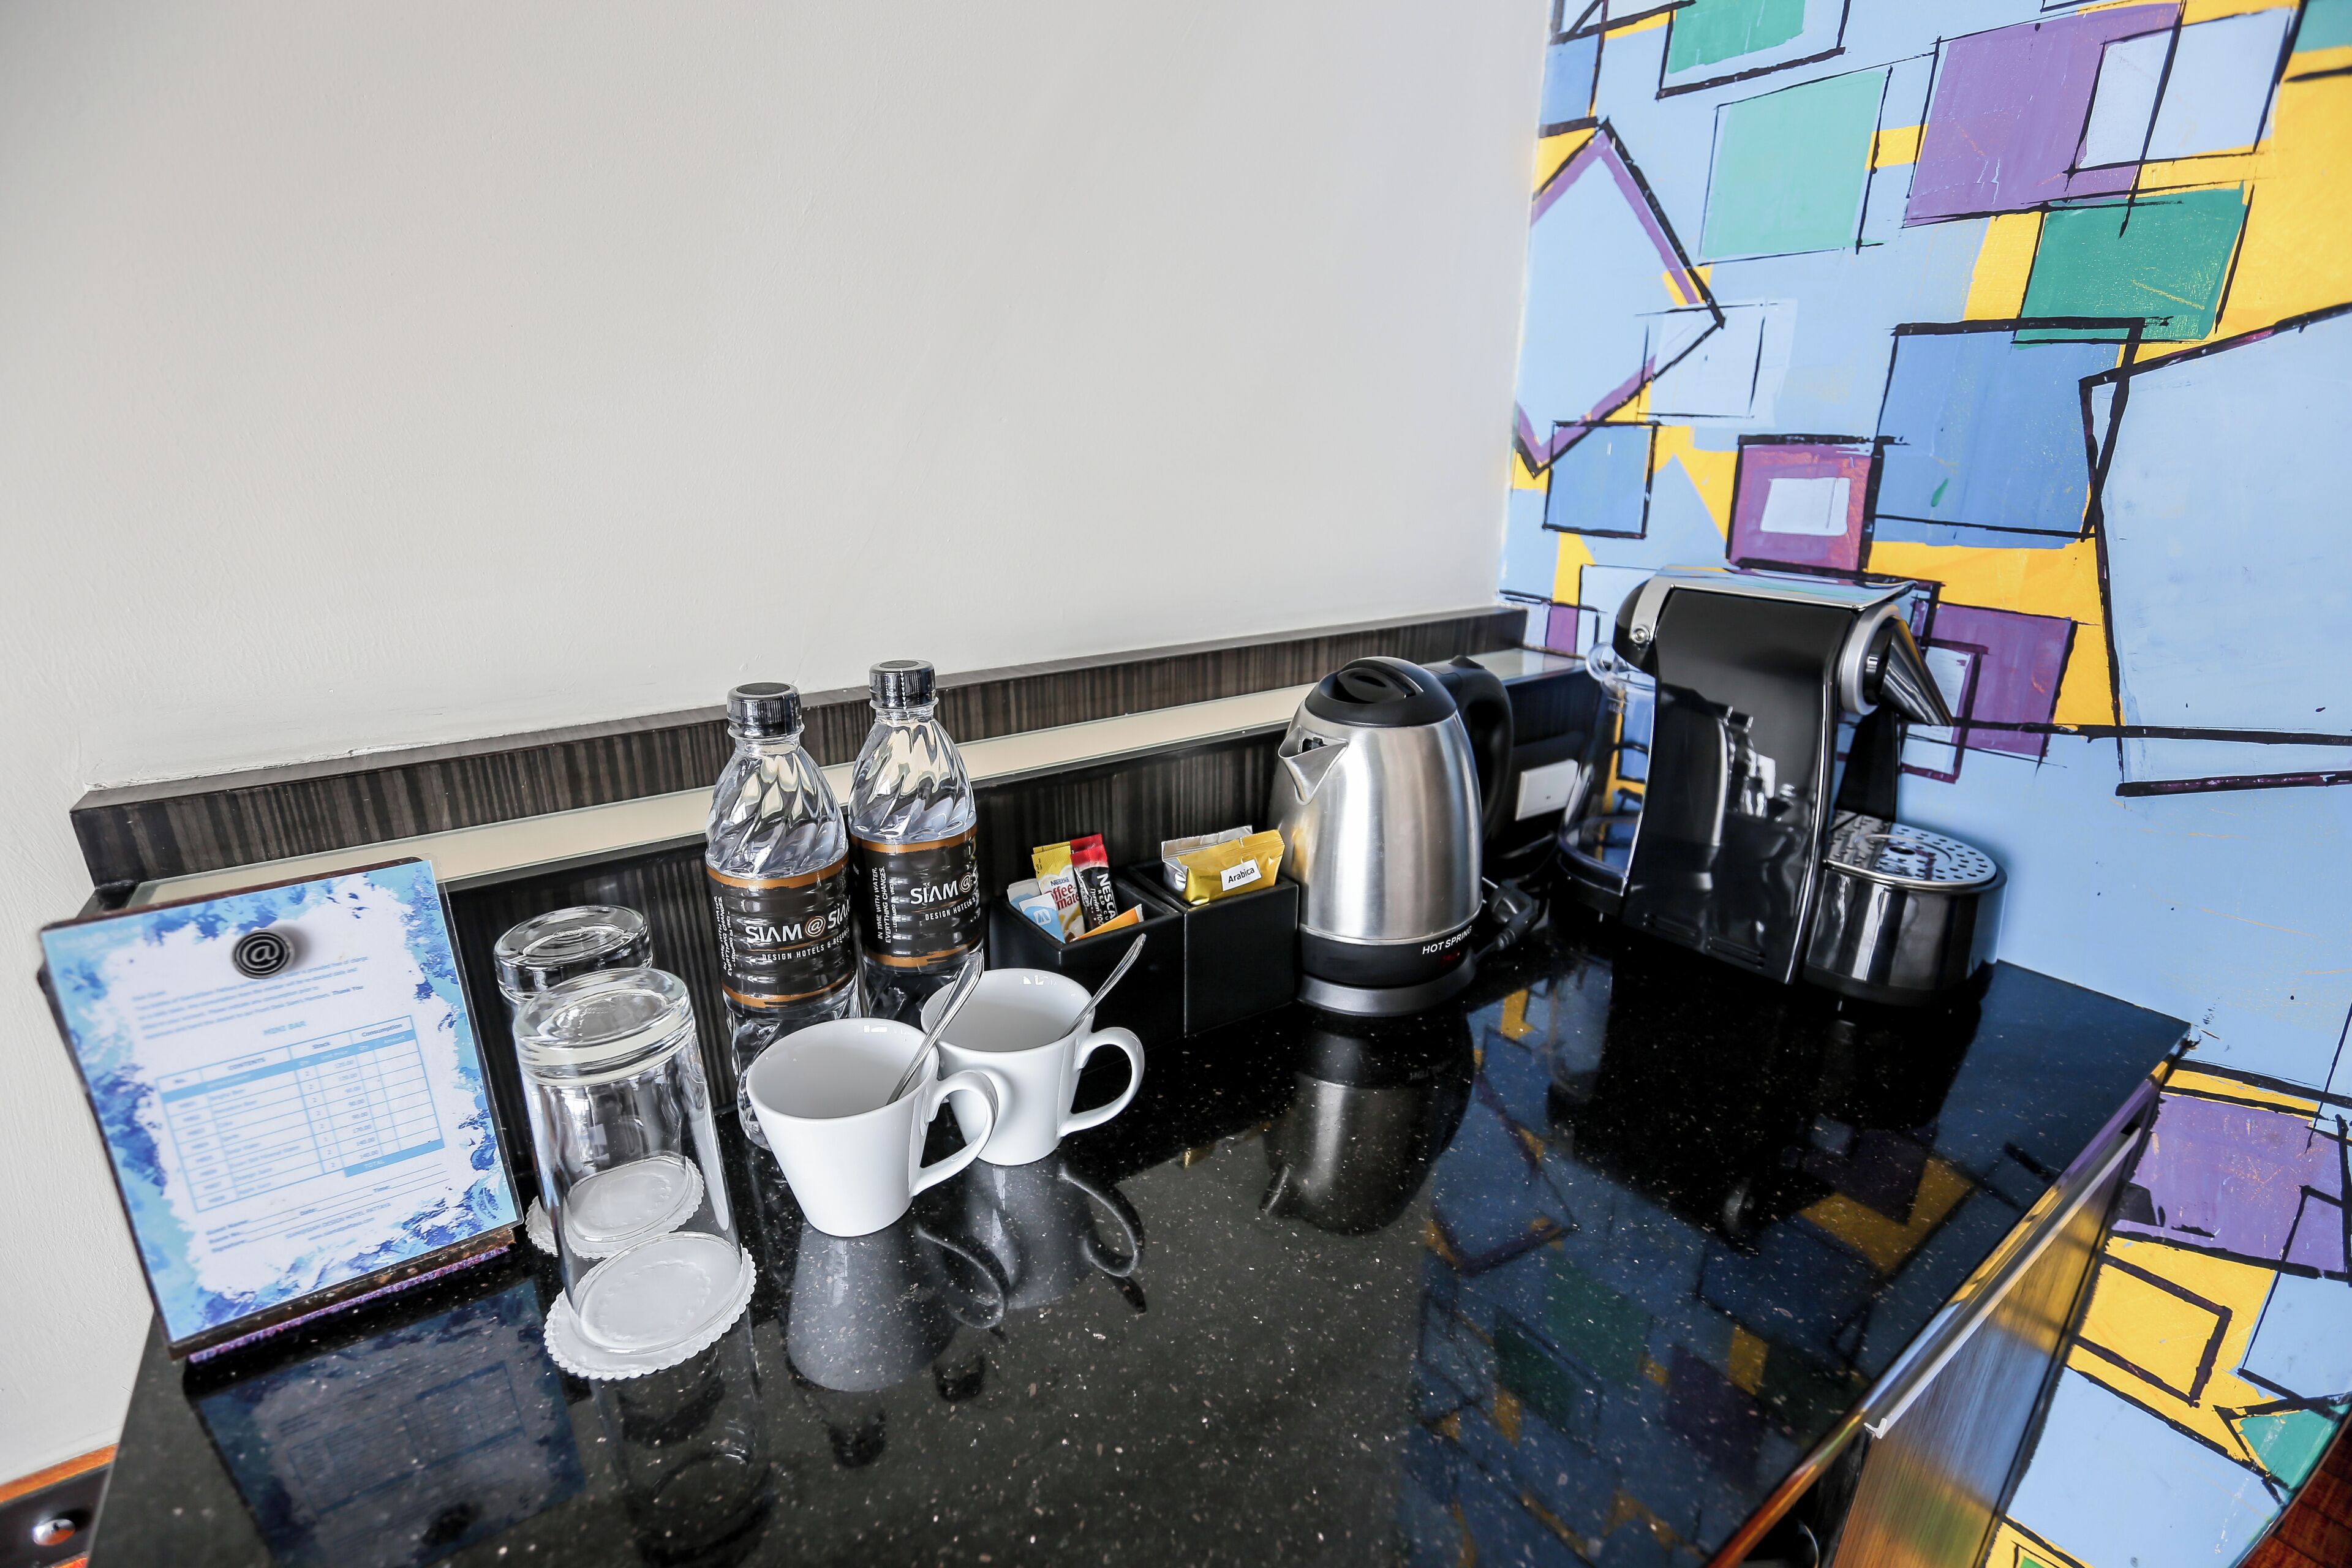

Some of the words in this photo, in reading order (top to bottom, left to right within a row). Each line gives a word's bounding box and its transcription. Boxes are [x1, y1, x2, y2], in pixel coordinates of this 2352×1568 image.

[879, 866, 888, 900] CHANGES.
[1228, 868, 1255, 884] Arabica
[911, 881, 959, 905] SIAM
[1057, 894, 1079, 911] mate
[1097, 873, 1116, 919] NESCA
[883, 902, 891, 943] EVERYTHING
[925, 910, 951, 921] DESIGN
[745, 924, 803, 943] SIAM
[1422, 941, 1444, 955] HOT
[1446, 925, 1472, 948] SPRING
[723, 933, 733, 976] EVERYTHING
[762, 952, 792, 961] DESIGN
[796, 944, 824, 959] HOTELS
[311, 1040, 331, 1050] Stock
[360, 1022, 403, 1038] Consumption
